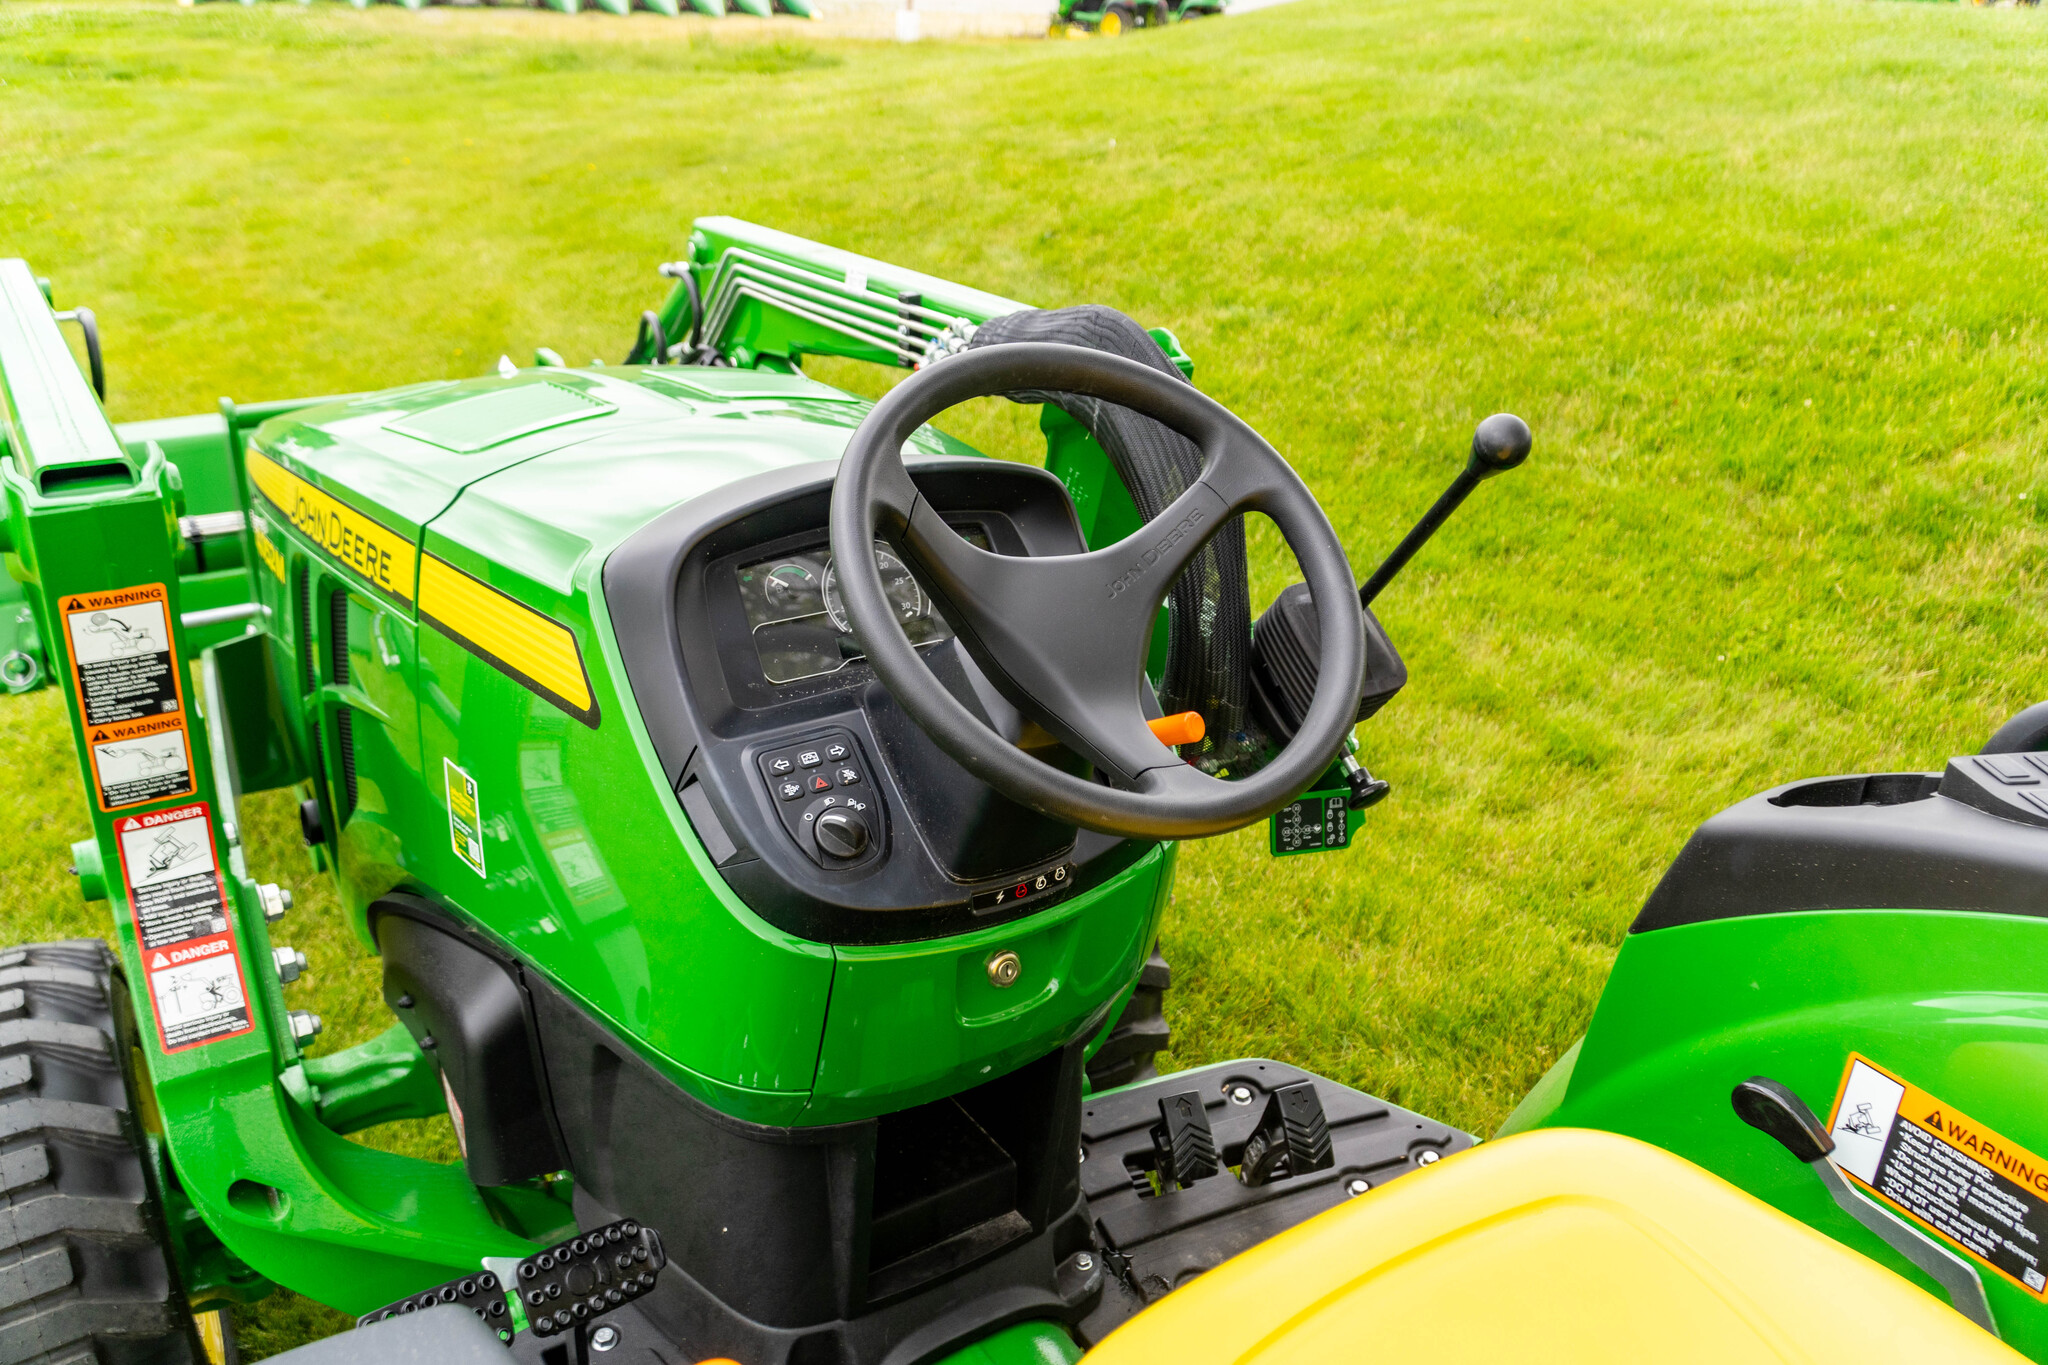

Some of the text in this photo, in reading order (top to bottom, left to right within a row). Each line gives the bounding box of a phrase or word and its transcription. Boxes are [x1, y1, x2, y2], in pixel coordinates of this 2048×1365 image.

[291, 486, 327, 543] JOHN
[330, 511, 392, 585] DEERE
[1105, 507, 1205, 600] JOHN DEERE
[879, 561, 889, 570] 20
[894, 577, 904, 586] 25
[88, 588, 162, 607] WARNING
[901, 602, 912, 611] 30
[113, 718, 182, 737] WARNING
[143, 806, 203, 826] DANGER
[170, 939, 230, 963] DANGER
[1900, 1120, 1932, 1143] AVOID
[1894, 1160, 1913, 1177] Use
[1914, 1174, 1936, 1192] seat
[1900, 1142, 1946, 1175] Structure
[1947, 1170, 1970, 1190] fully
[1903, 1132, 2029, 1213] Keep Rollover Protective
[1949, 1120, 2048, 1193] WARNING
[1886, 1164, 1912, 1188] When
[1914, 1185, 1959, 1216] structure
[1960, 1213, 1987, 1234] must
[1988, 1229, 2002, 1243] be
[1888, 1178, 1904, 1192] DO
[1905, 1189, 1929, 1207] NOT
[1929, 1205, 1948, 1220] use
[1949, 1218, 1972, 1236] seat
[1896, 1150, 1912, 1164] Do
[1912, 1162, 1930, 1177] not
[1930, 1171, 1957, 1196] jump
[1958, 1188, 1967, 1198] if
[1967, 1195, 2013, 1227] machine
[1885, 1187, 1911, 1208] Drive
[1913, 1205, 1933, 1223] with
[1935, 1220, 1961, 1240] extra
